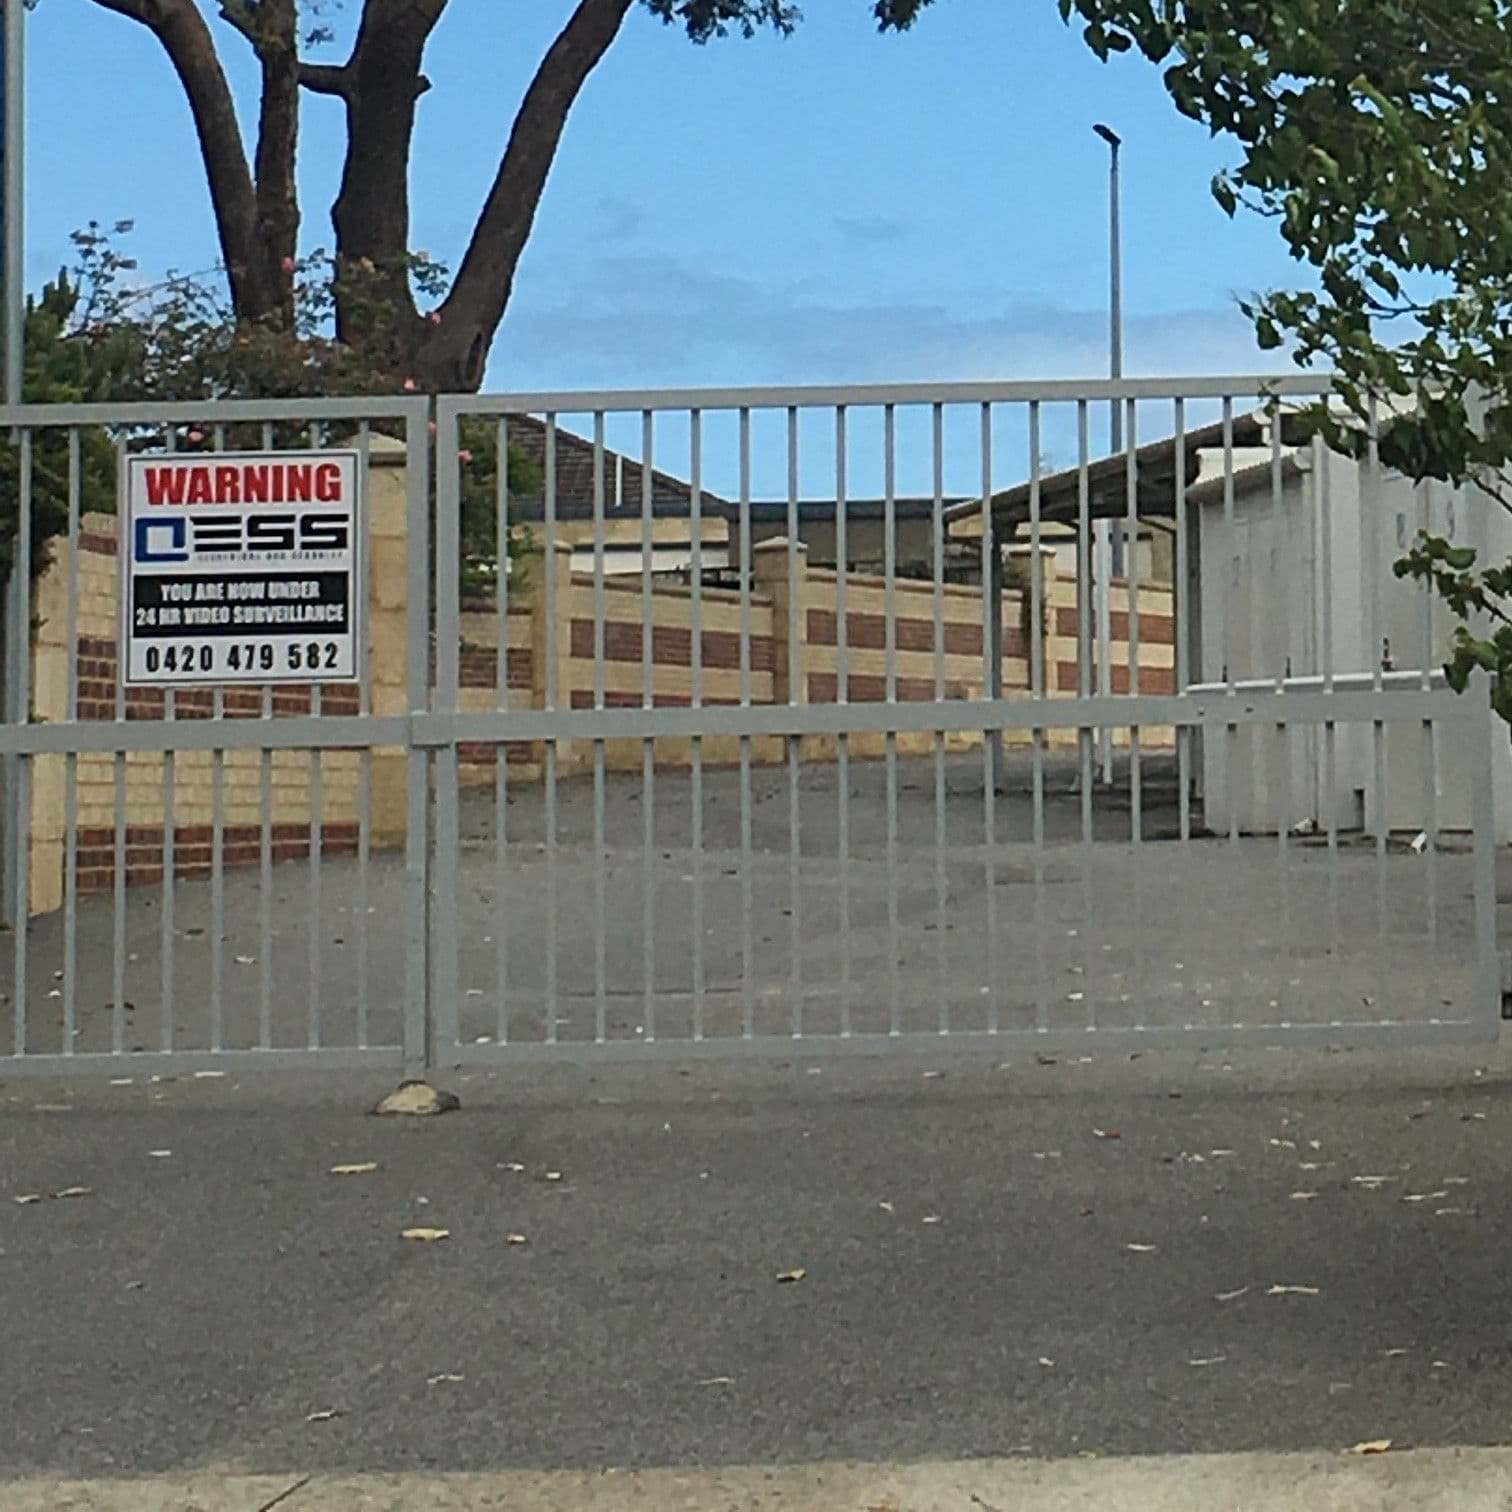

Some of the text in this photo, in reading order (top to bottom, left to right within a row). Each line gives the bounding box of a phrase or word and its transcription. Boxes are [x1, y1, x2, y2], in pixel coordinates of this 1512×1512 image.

[144, 464, 341, 505] WARNING
[161, 581, 319, 601] YOU ARE NOW UNDER
[137, 608, 156, 625] 24
[184, 606, 229, 624] VIDEO
[233, 604, 344, 623] SURVEILLANCE
[146, 642, 338, 672] 0420 479 582
